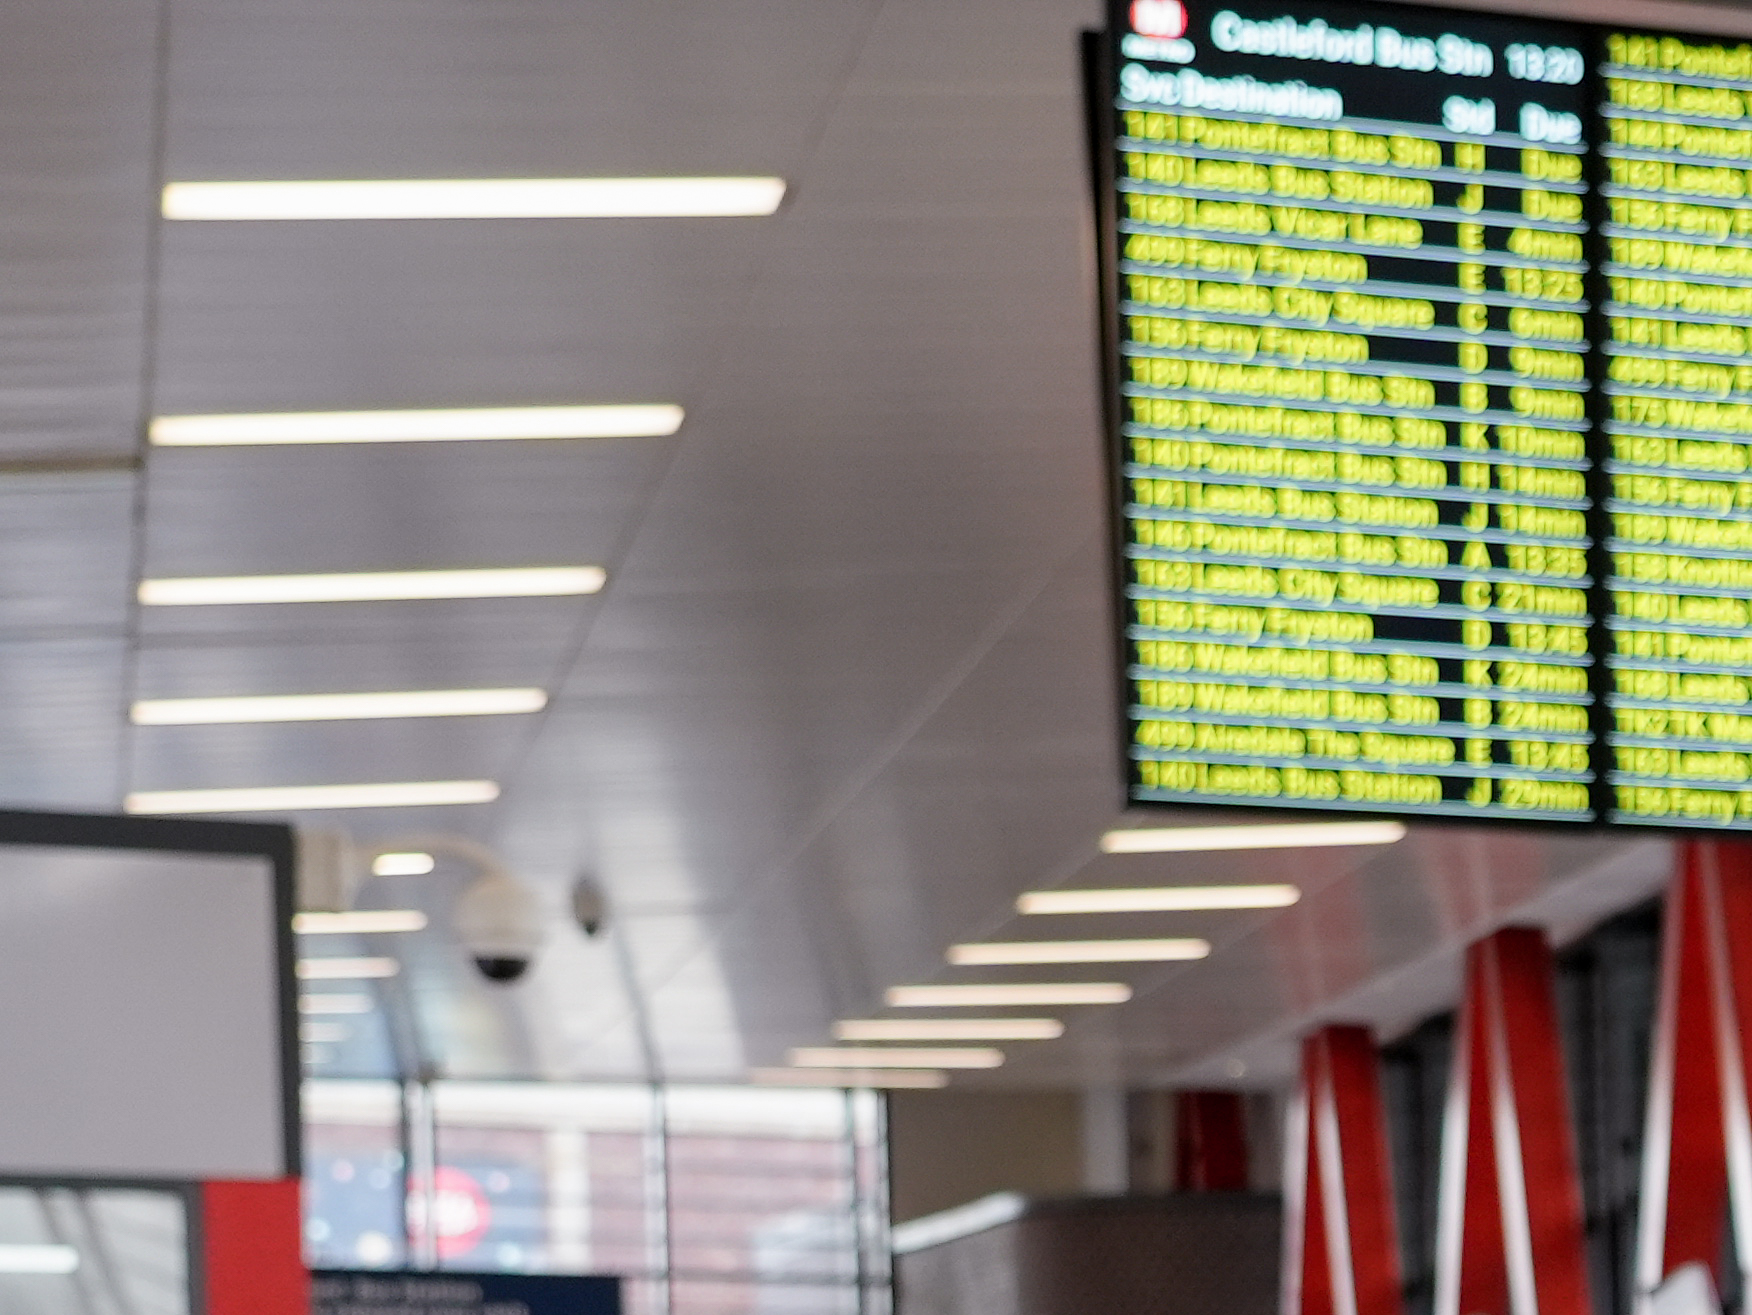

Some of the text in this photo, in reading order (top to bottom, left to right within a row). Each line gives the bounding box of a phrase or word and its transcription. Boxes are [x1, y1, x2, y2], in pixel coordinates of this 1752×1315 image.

[1211, 10, 1374, 65] Castleford
[1375, 27, 1437, 72] Bus
[1437, 33, 1494, 77] Stn
[1179, 68, 1343, 121] Destination
[1520, 103, 1582, 145] Due
[1330, 127, 1389, 166] Bus
[1521, 144, 1582, 183] Due
[1183, 155, 1270, 196] Leeds
[1270, 163, 1329, 202] Bus
[1329, 168, 1433, 210] Station
[1455, 179, 1483, 215] J
[1521, 185, 1582, 223] Due
[1183, 196, 1271, 237] Leeds
[1348, 210, 1423, 250] Lane
[1185, 277, 1273, 318] Leeds
[1273, 284, 1334, 329] City
[1333, 289, 1435, 337] Square
[1458, 299, 1488, 335] C
[1190, 561, 1278, 600] Leeds
[1279, 567, 1338, 610] City
[1338, 570, 1439, 616] Square
[1462, 579, 1491, 614] C
[1194, 762, 1282, 800] Leeds
[1282, 767, 1340, 803] Bus
[1339, 770, 1442, 808] Station
[1465, 777, 1492, 811] J
